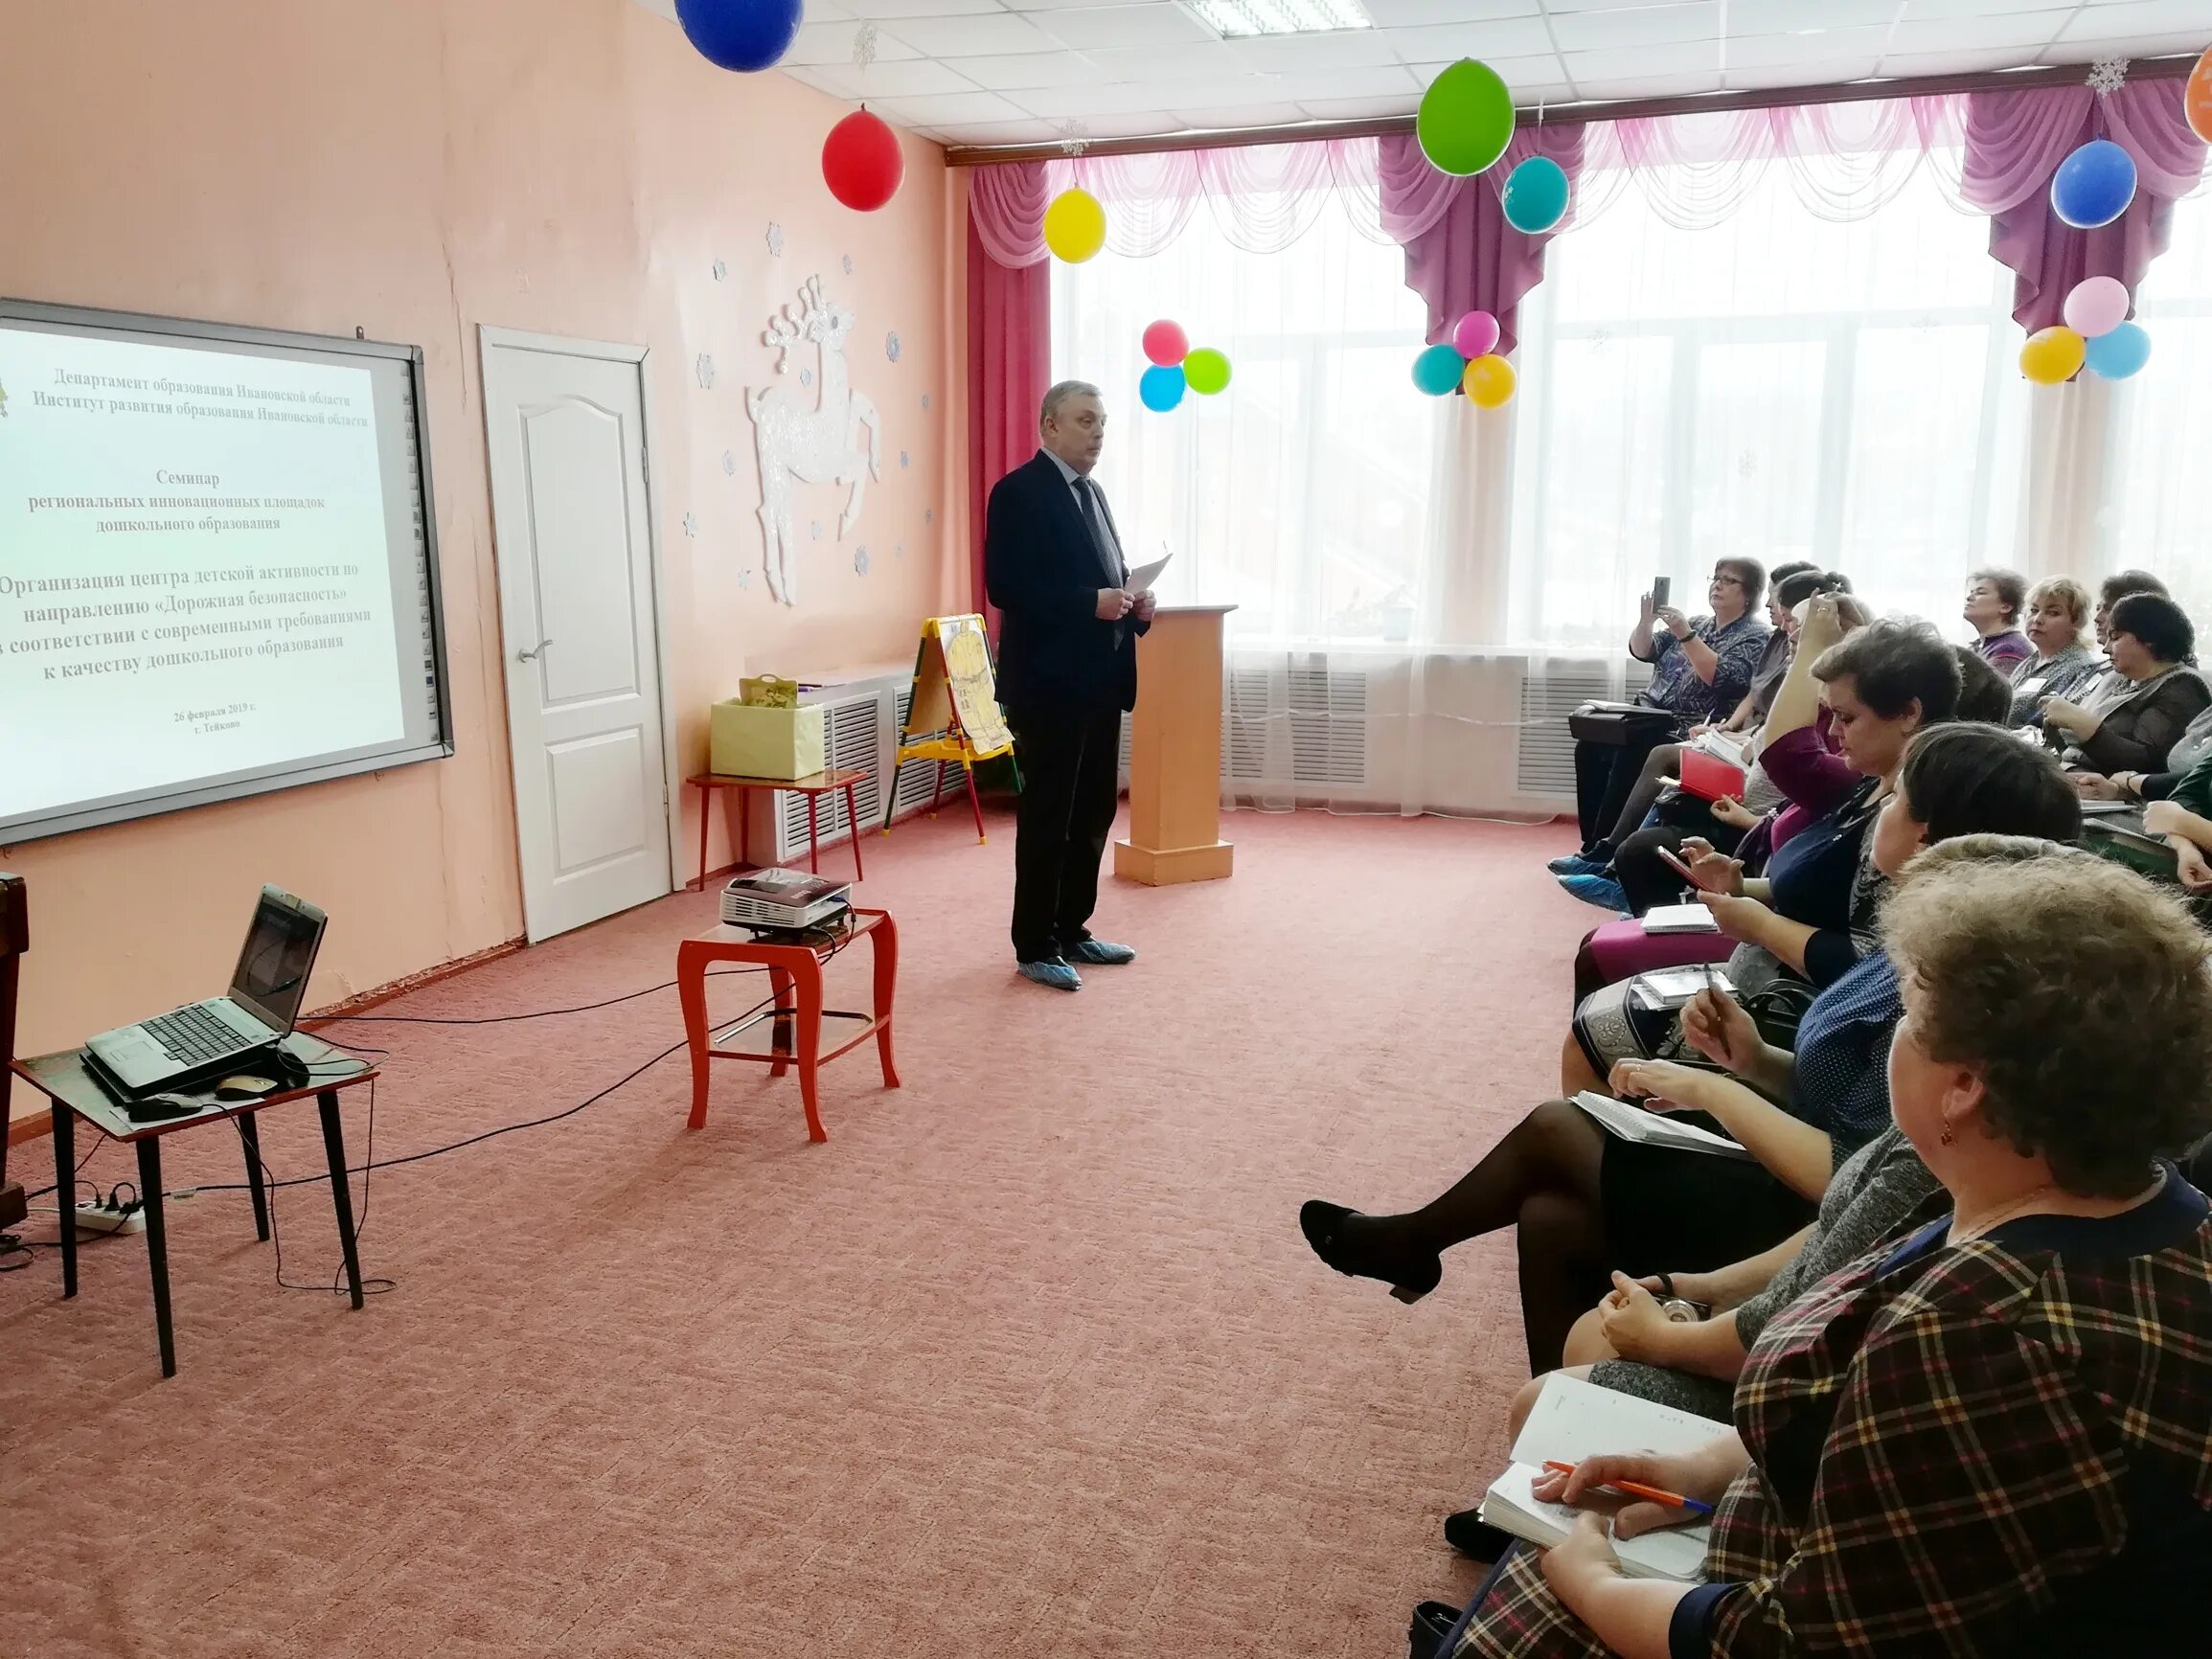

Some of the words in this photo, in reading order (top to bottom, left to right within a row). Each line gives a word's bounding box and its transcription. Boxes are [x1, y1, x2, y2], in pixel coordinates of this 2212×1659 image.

[55, 368, 149, 390] Департамент
[153, 377, 233, 397] образования
[237, 384, 307, 402] Ивановской
[309, 391, 351, 407] области
[33, 390, 104, 413] Институт
[110, 399, 172, 414] развития
[176, 401, 254, 420] образования
[258, 407, 325, 424] Ивановской
[328, 413, 368, 427] области
[156, 469, 220, 489] Семинар
[28, 496, 145, 512] региональных
[149, 496, 261, 510] инновационных
[264, 497, 326, 510] площадок
[96, 519, 194, 534] дошкольного
[198, 516, 281, 534] образования
[0, 575, 125, 599] Организация
[130, 571, 190, 589] центра
[194, 565, 255, 584] детской
[259, 564, 339, 580] активности
[343, 564, 358, 576] по
[23, 601, 149, 625] направлению
[154, 593, 244, 614] «Дорожная
[249, 589, 347, 606] безопасность»
[10, 630, 135, 653] соответствии
[141, 628, 148, 641] с
[154, 619, 272, 642] современными
[276, 610, 371, 632] требованиями
[44, 667, 57, 680] к
[61, 657, 141, 678] качеству
[146, 646, 253, 670] дошкольного
[257, 636, 344, 658] образования
[174, 712, 185, 722] 26
[187, 708, 226, 722] февраля
[228, 702, 248, 715] 2019
[204, 720, 240, 733] Тейково
